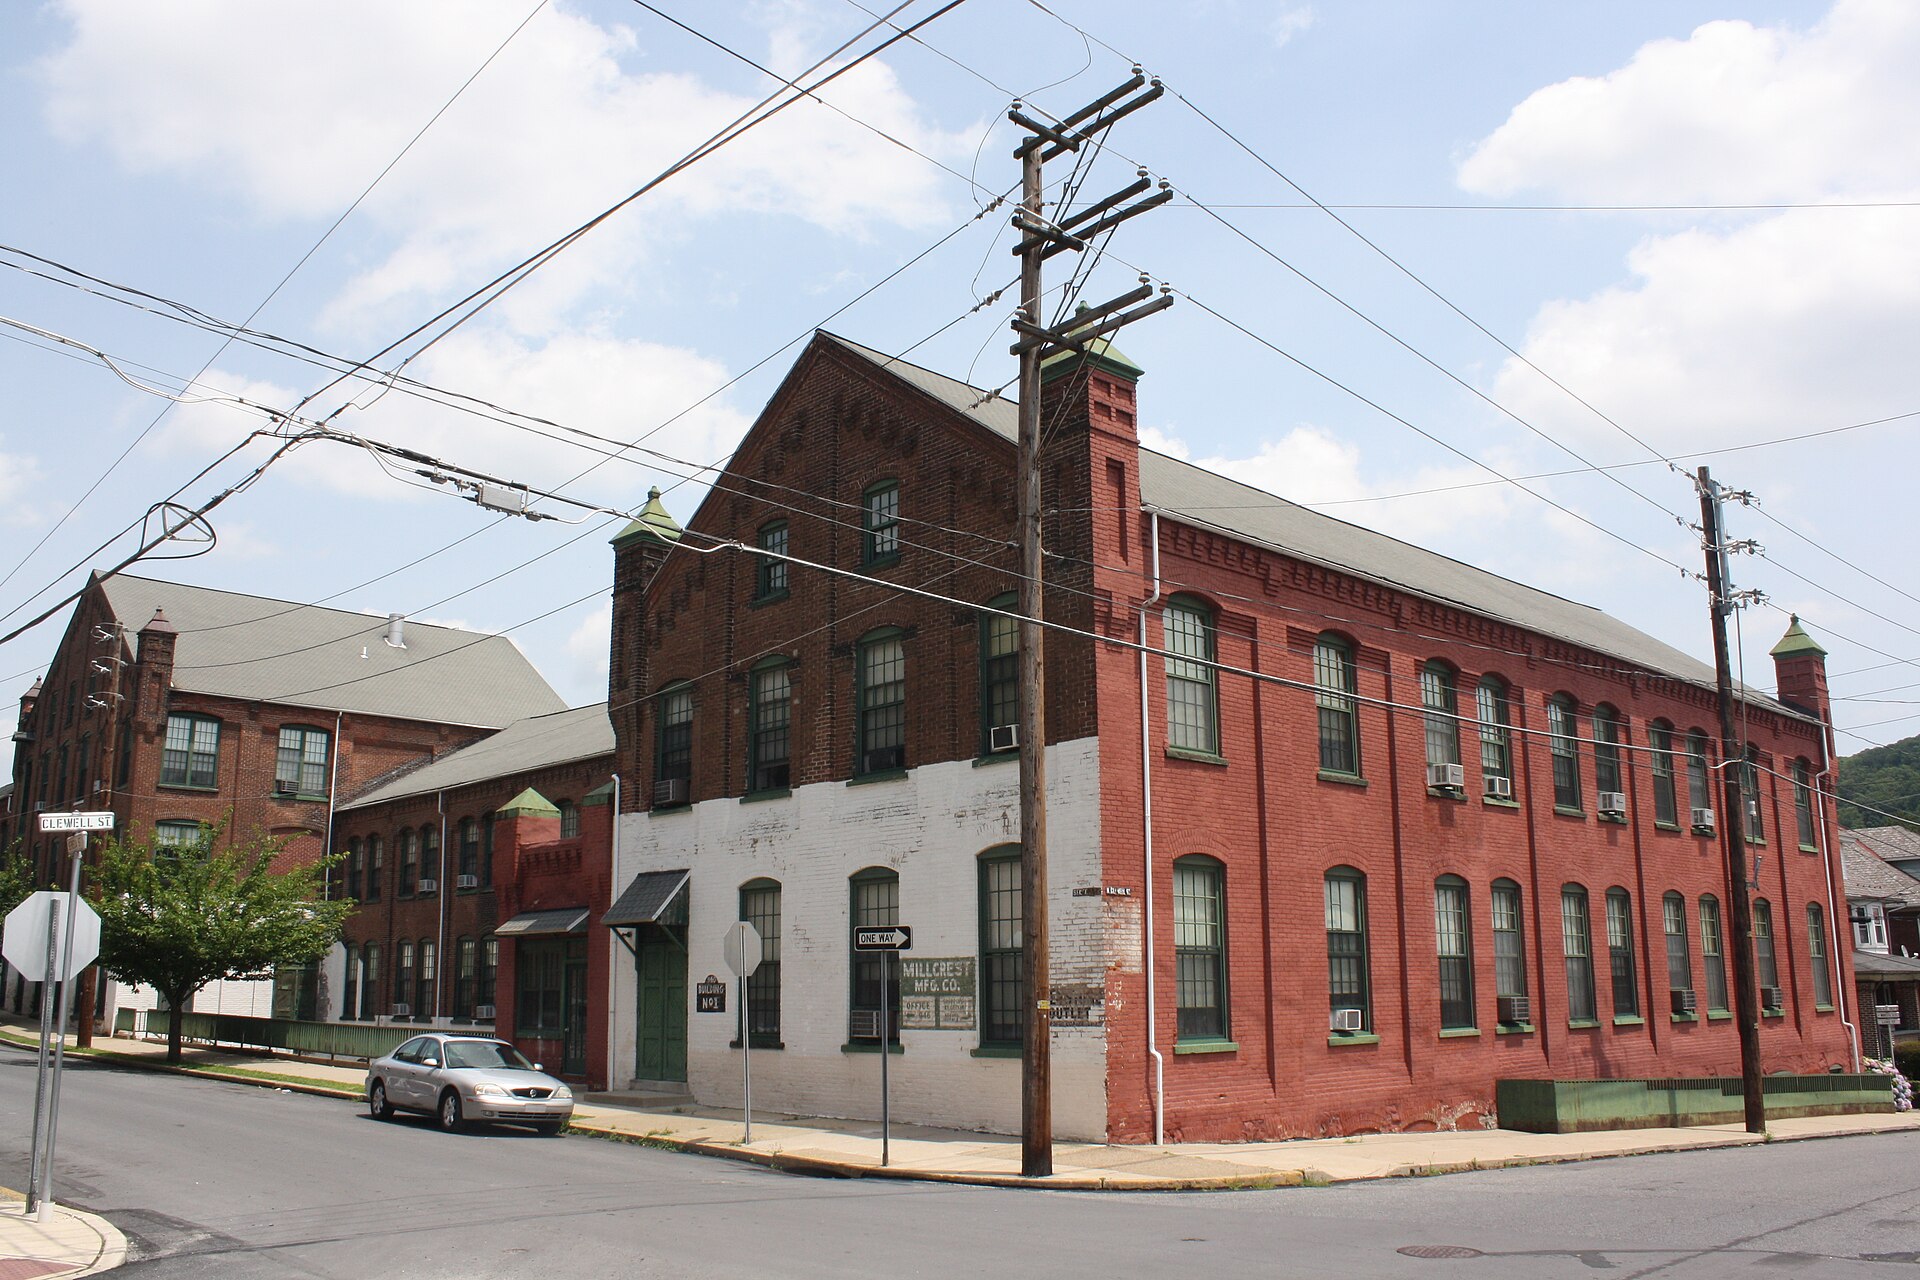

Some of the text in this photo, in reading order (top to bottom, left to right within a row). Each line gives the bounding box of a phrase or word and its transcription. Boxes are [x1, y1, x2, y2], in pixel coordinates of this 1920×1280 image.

[42, 818, 93, 829] CLEWELL
[860, 933, 895, 943] ONE WAY
[903, 961, 971, 978] MILLCREST
[698, 984, 724, 995] BUILDING
[914, 978, 961, 992] MFG. CO.
[906, 1002, 930, 1010] OFFICE
[1049, 1006, 1090, 1020] OUTLET
